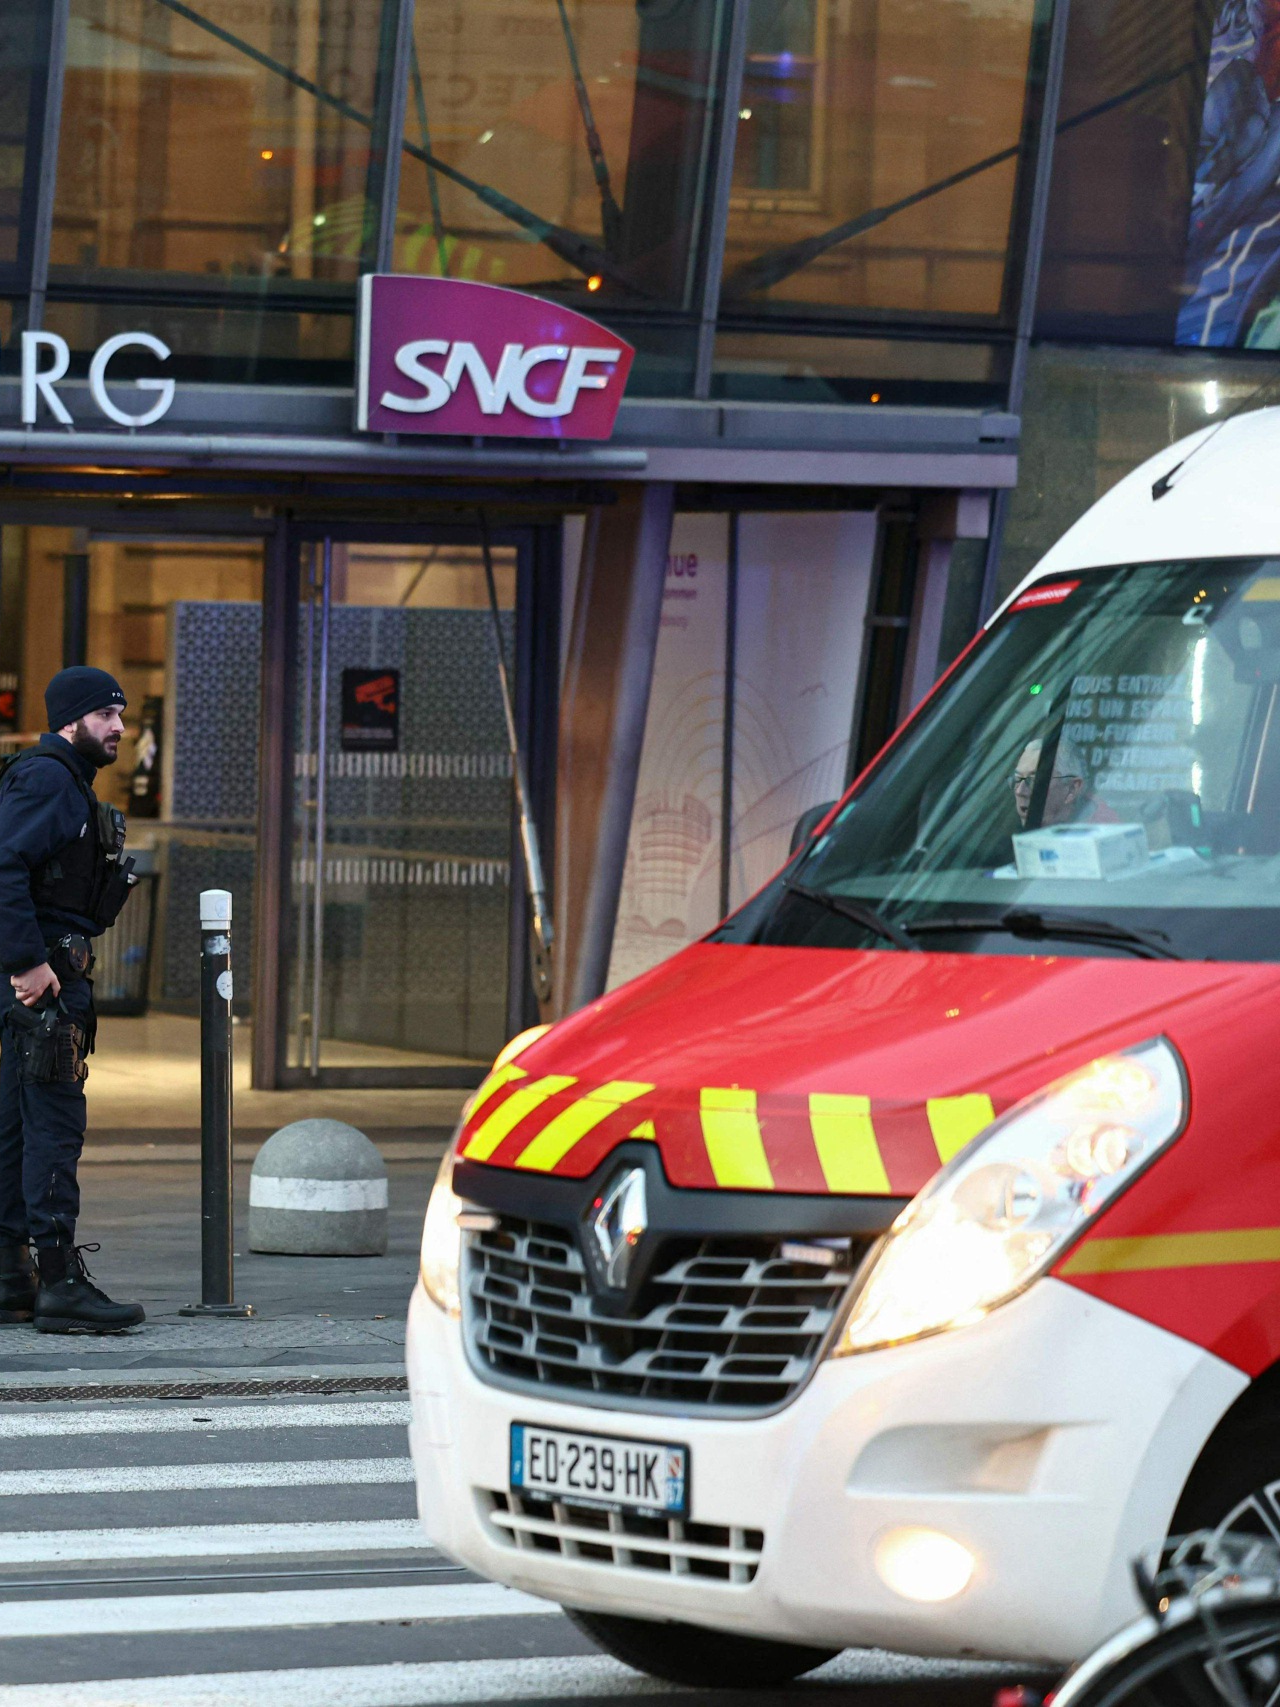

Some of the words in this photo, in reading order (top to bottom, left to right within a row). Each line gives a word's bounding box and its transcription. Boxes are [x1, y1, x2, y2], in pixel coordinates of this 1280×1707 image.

[380, 339, 622, 419] SNCF
[1116, 674, 1184, 694] ENTR
[529, 1435, 659, 1501] ED-239-HK
